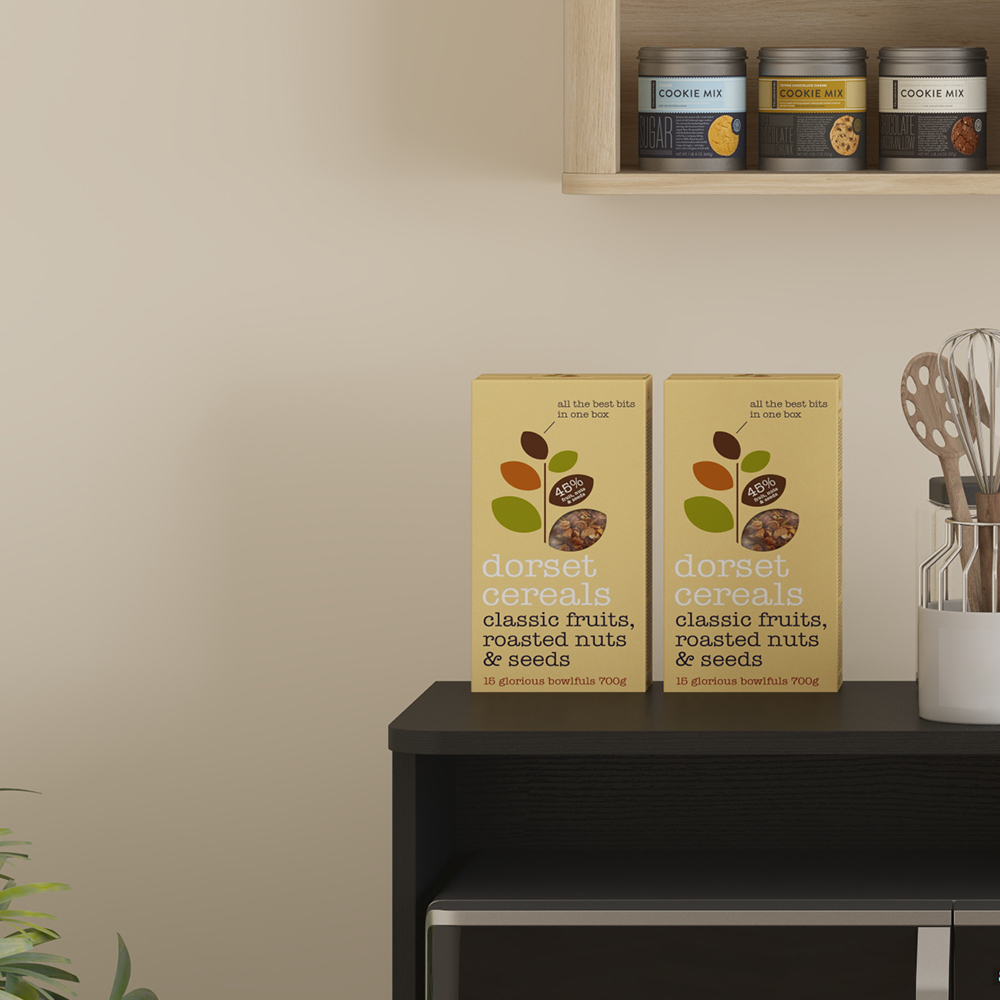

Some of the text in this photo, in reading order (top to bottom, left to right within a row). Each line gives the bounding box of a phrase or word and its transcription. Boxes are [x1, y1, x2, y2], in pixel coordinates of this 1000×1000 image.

[658, 89, 723, 98] COOKIE MIX
[780, 89, 843, 98] COOKIE MIX
[901, 89, 964, 98] COOKIE MIX
[639, 115, 673, 149] SUGAR
[555, 477, 584, 497] 45%
[747, 477, 776, 497] 45%
[482, 554, 597, 578] dorset
[675, 554, 789, 578] dorset
[482, 582, 611, 606] cereals
[675, 582, 803, 606] cereals
[483, 612, 634, 630] classic fruits,
[675, 612, 827, 630] classic fruits,
[483, 632, 627, 647] roasted nuts
[675, 632, 819, 647] roasted nuts
[483, 651, 570, 667] & seeds
[675, 651, 763, 667] & seeds
[483, 677, 627, 687] 15 glorious bowlfuls 700g
[676, 677, 819, 687] 15 glorious bowlfuls 700g
